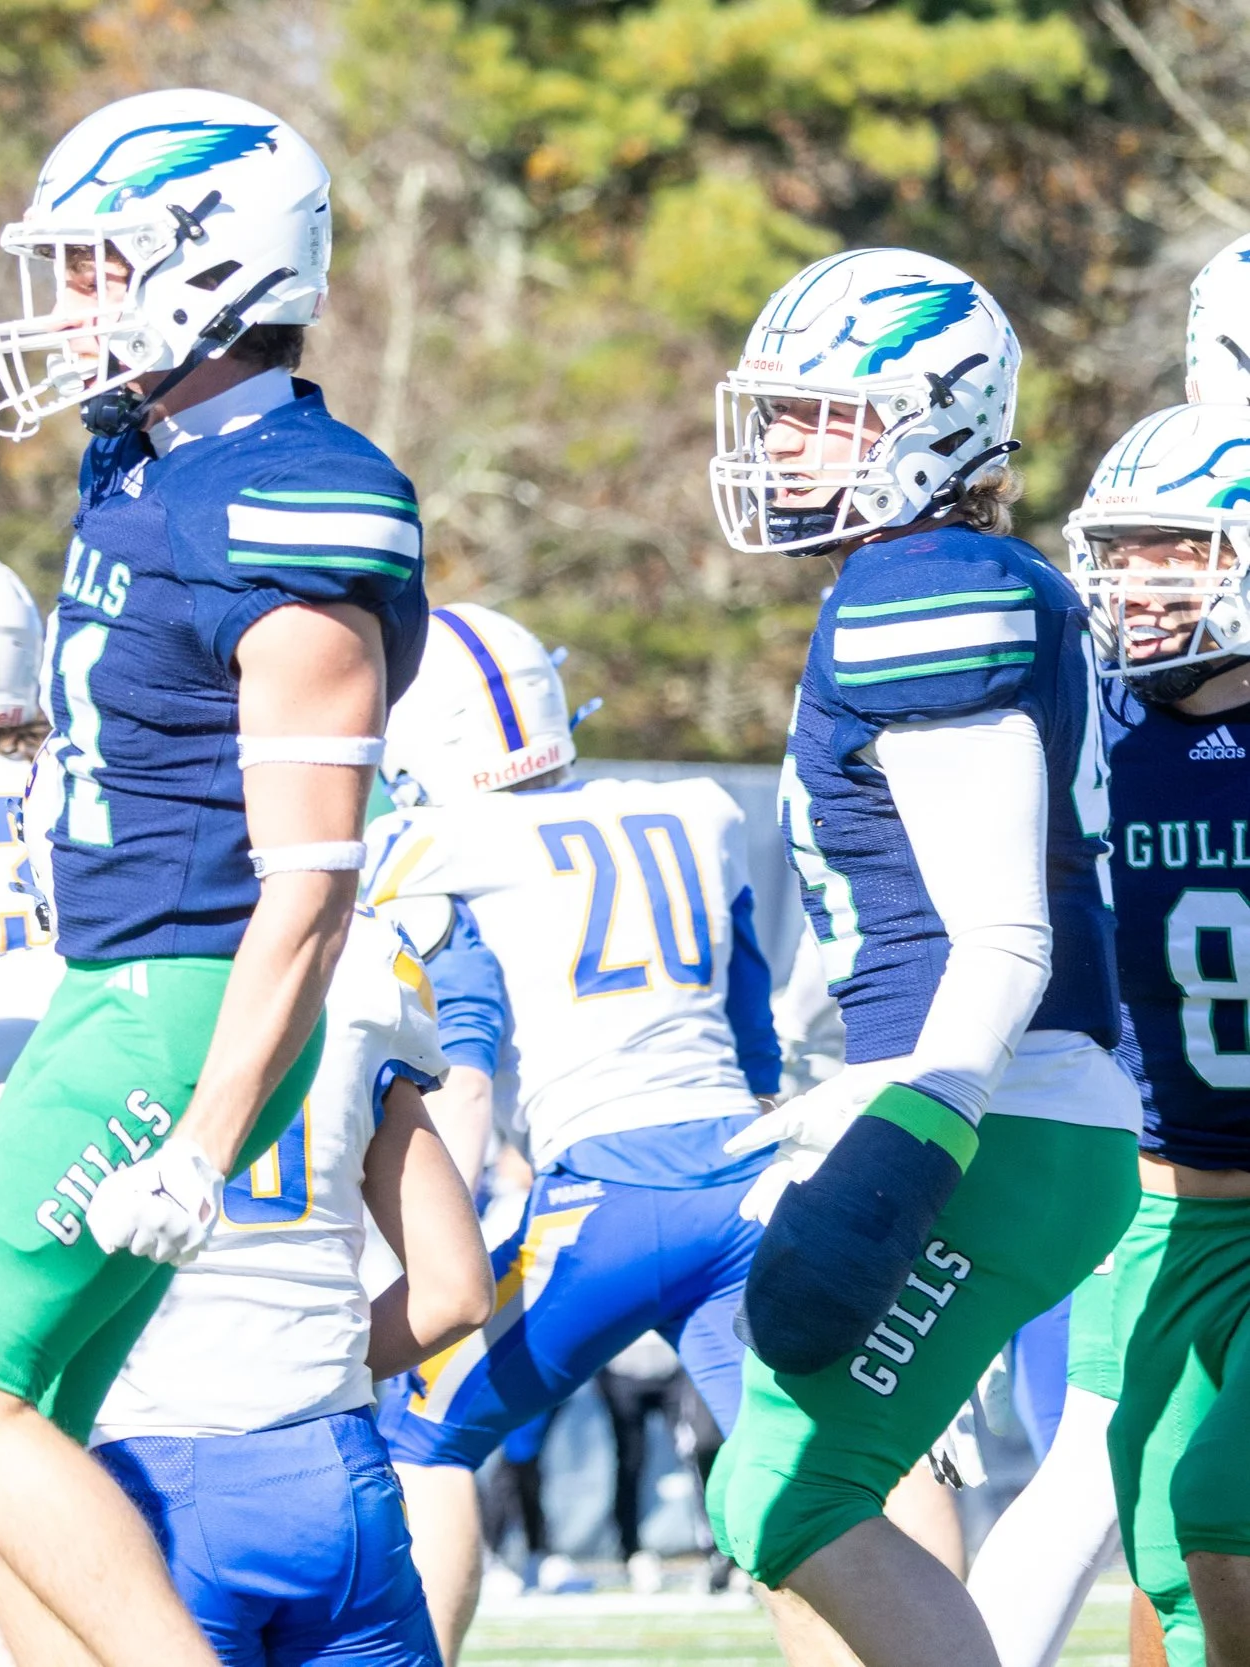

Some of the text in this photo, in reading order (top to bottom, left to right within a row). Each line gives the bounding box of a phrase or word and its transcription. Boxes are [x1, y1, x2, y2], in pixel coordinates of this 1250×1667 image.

[62, 534, 132, 619] LLS
[473, 745, 560, 790] Riddell
[1189, 745, 1246, 760] adidas
[1125, 820, 1250, 870] GULL
[534, 813, 714, 1003] 20
[1164, 888, 1250, 1089] 8
[849, 1239, 973, 1398] GULLS
